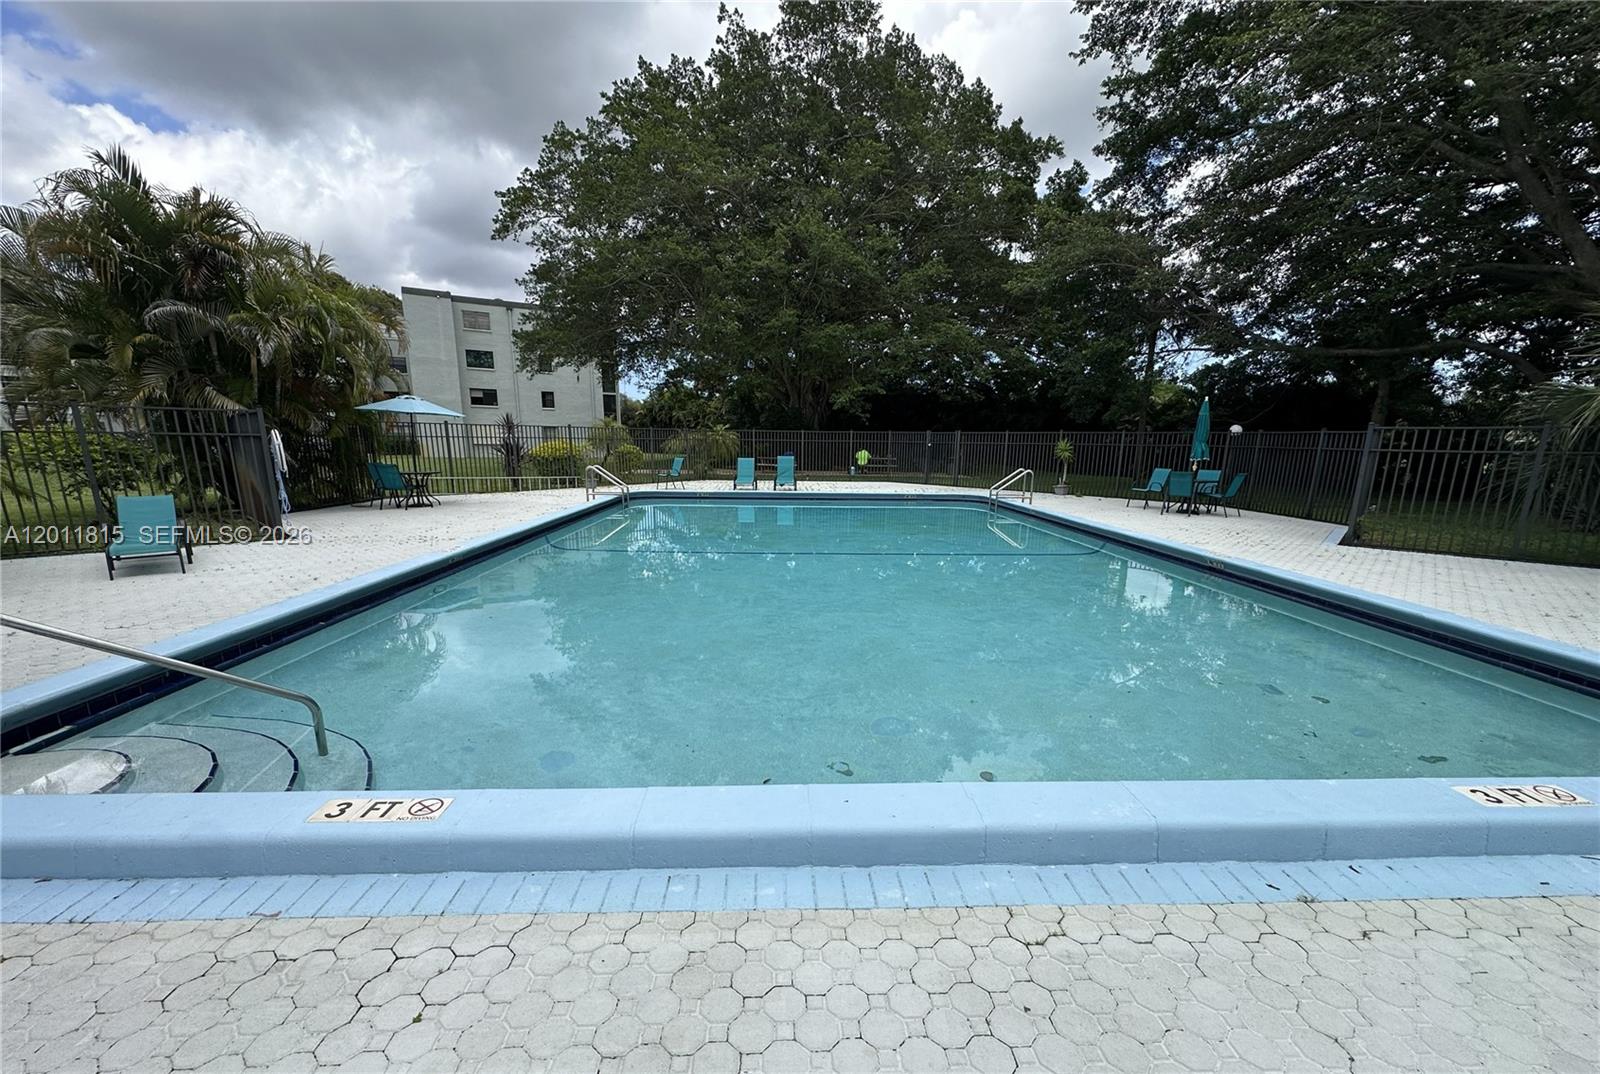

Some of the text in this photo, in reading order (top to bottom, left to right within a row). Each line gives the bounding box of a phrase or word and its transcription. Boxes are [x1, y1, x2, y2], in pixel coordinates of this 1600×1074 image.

[1469, 787, 1544, 804] 3 FT
[324, 800, 404, 819] 3 FT
